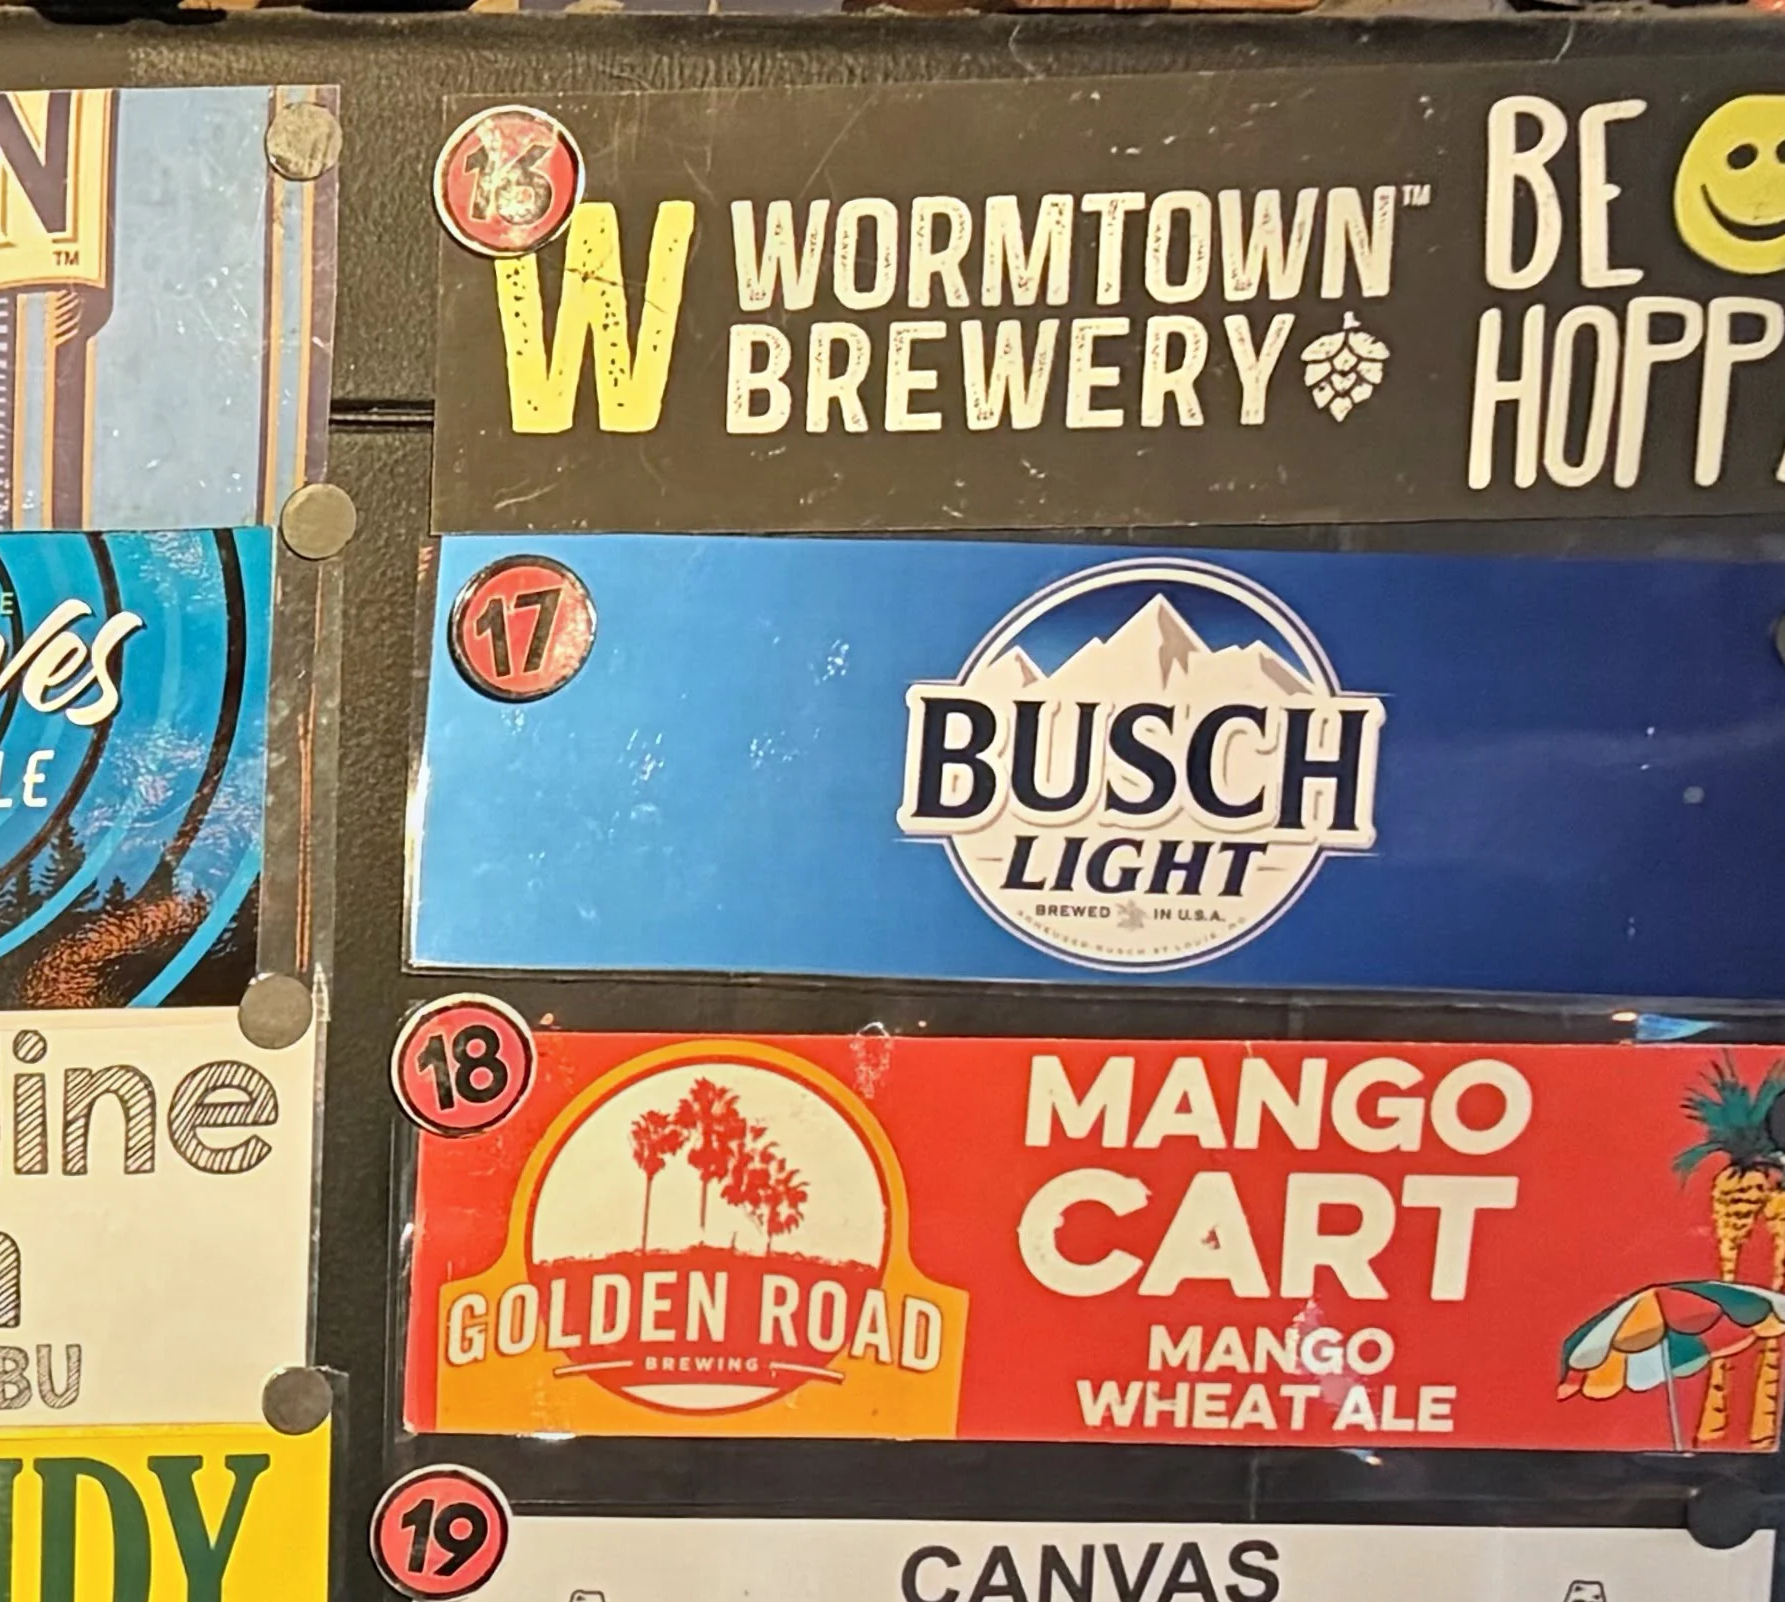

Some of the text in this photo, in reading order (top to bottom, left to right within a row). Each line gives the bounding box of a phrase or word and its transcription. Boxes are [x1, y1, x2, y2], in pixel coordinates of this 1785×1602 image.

[1486, 95, 1649, 290] BE
[731, 184, 1393, 313] WORMTOWN
[725, 311, 1295, 434] BREWERY
[472, 592, 564, 679] 17
[911, 694, 1374, 834] BUSCH
[1000, 834, 1268, 897] LIGHT
[1035, 901, 1226, 924] BREWED IN U.S.A.
[416, 1026, 512, 1110] 18
[1025, 1055, 1532, 1153] MANGO
[1019, 1169, 1519, 1301] CART
[447, 1268, 943, 1366] GOLDEN ROAD
[1146, 1326, 1395, 1377] MANGO
[1077, 1383, 1456, 1432] WHEAT ALE
[399, 1499, 489, 1575] 19
